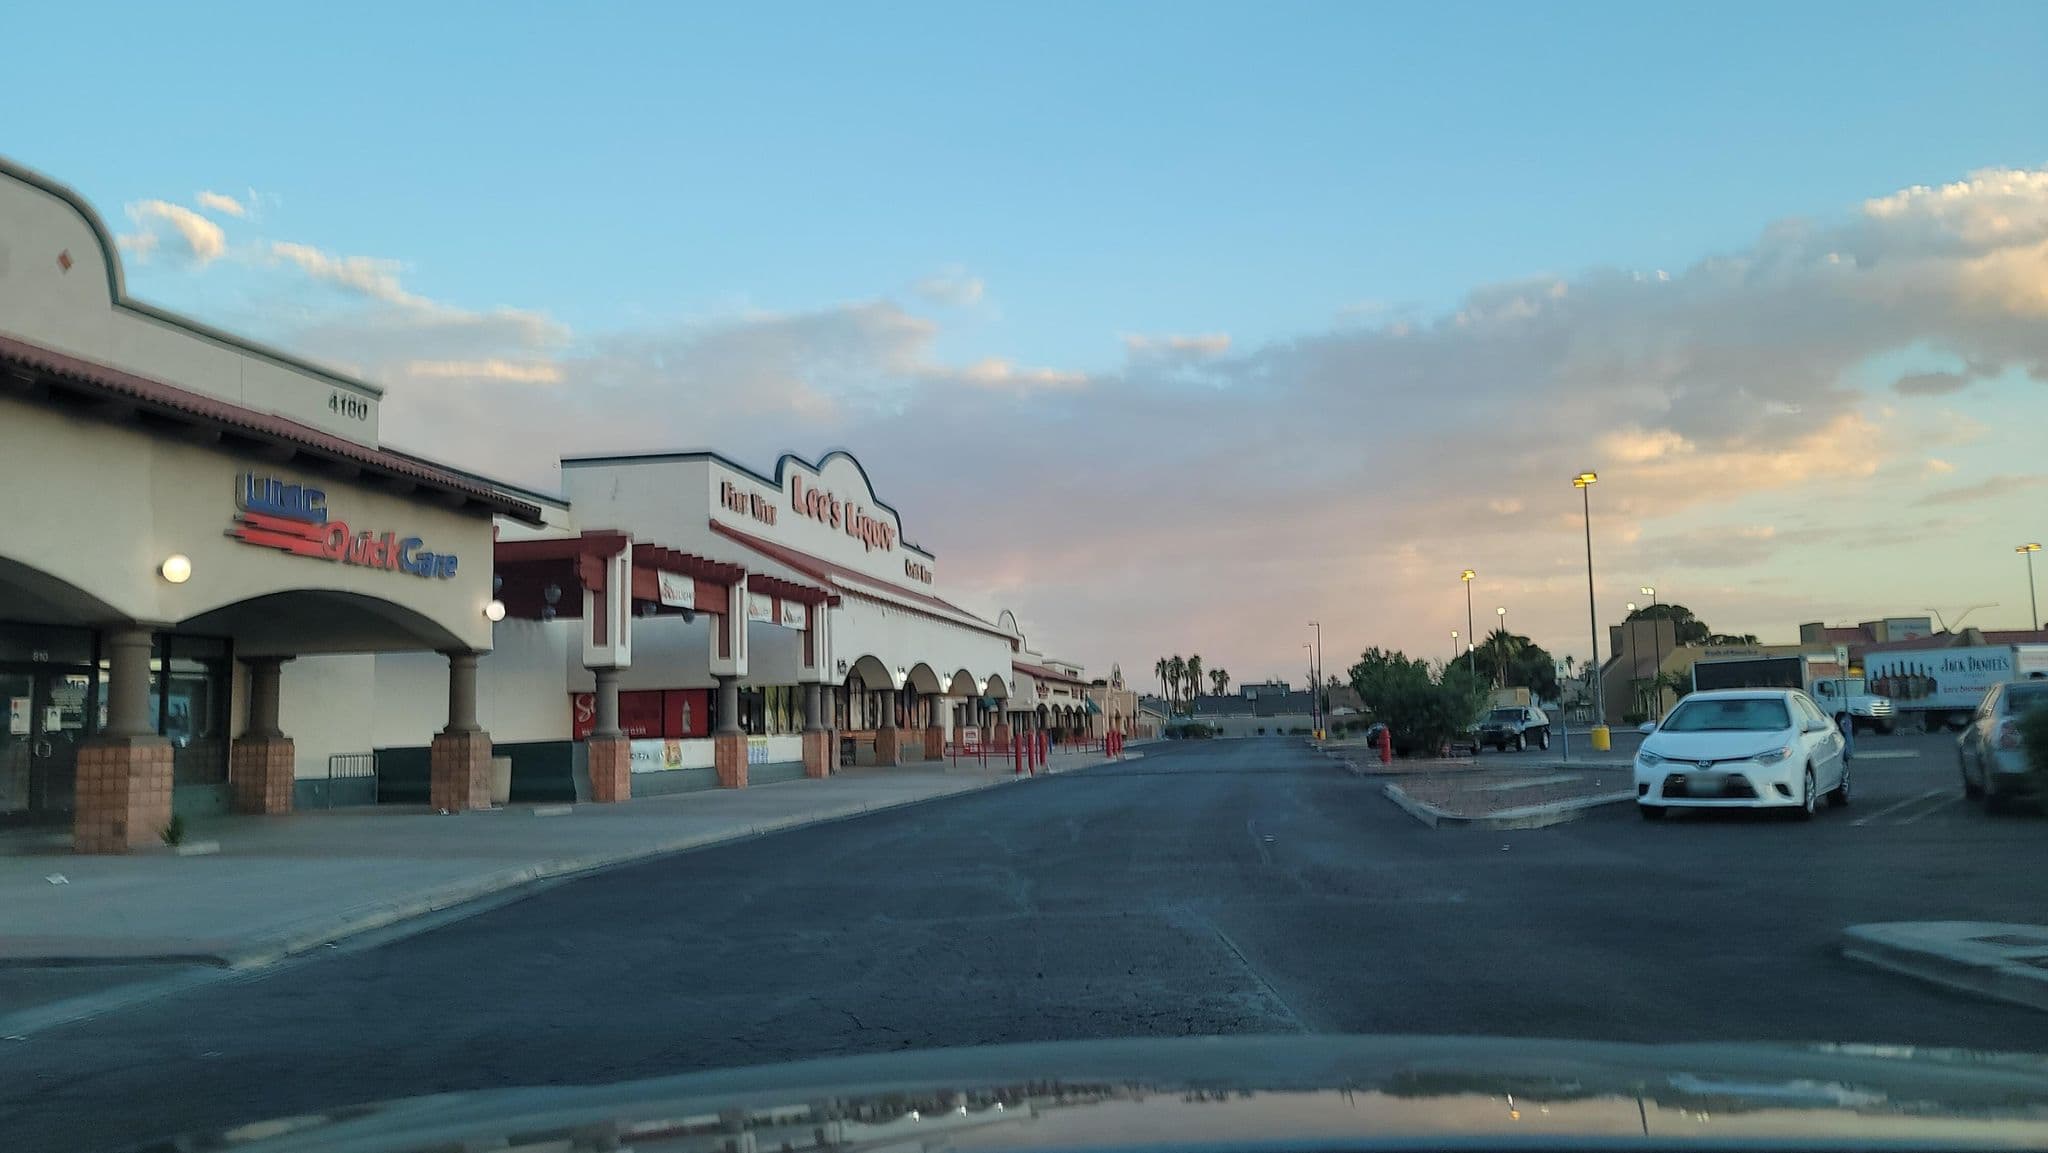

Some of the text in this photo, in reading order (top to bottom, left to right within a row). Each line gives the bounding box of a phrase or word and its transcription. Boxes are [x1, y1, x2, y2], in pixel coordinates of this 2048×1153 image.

[328, 394, 368, 421] 4180
[235, 472, 328, 523] UMC
[792, 475, 895, 552] Lee's Liquor
